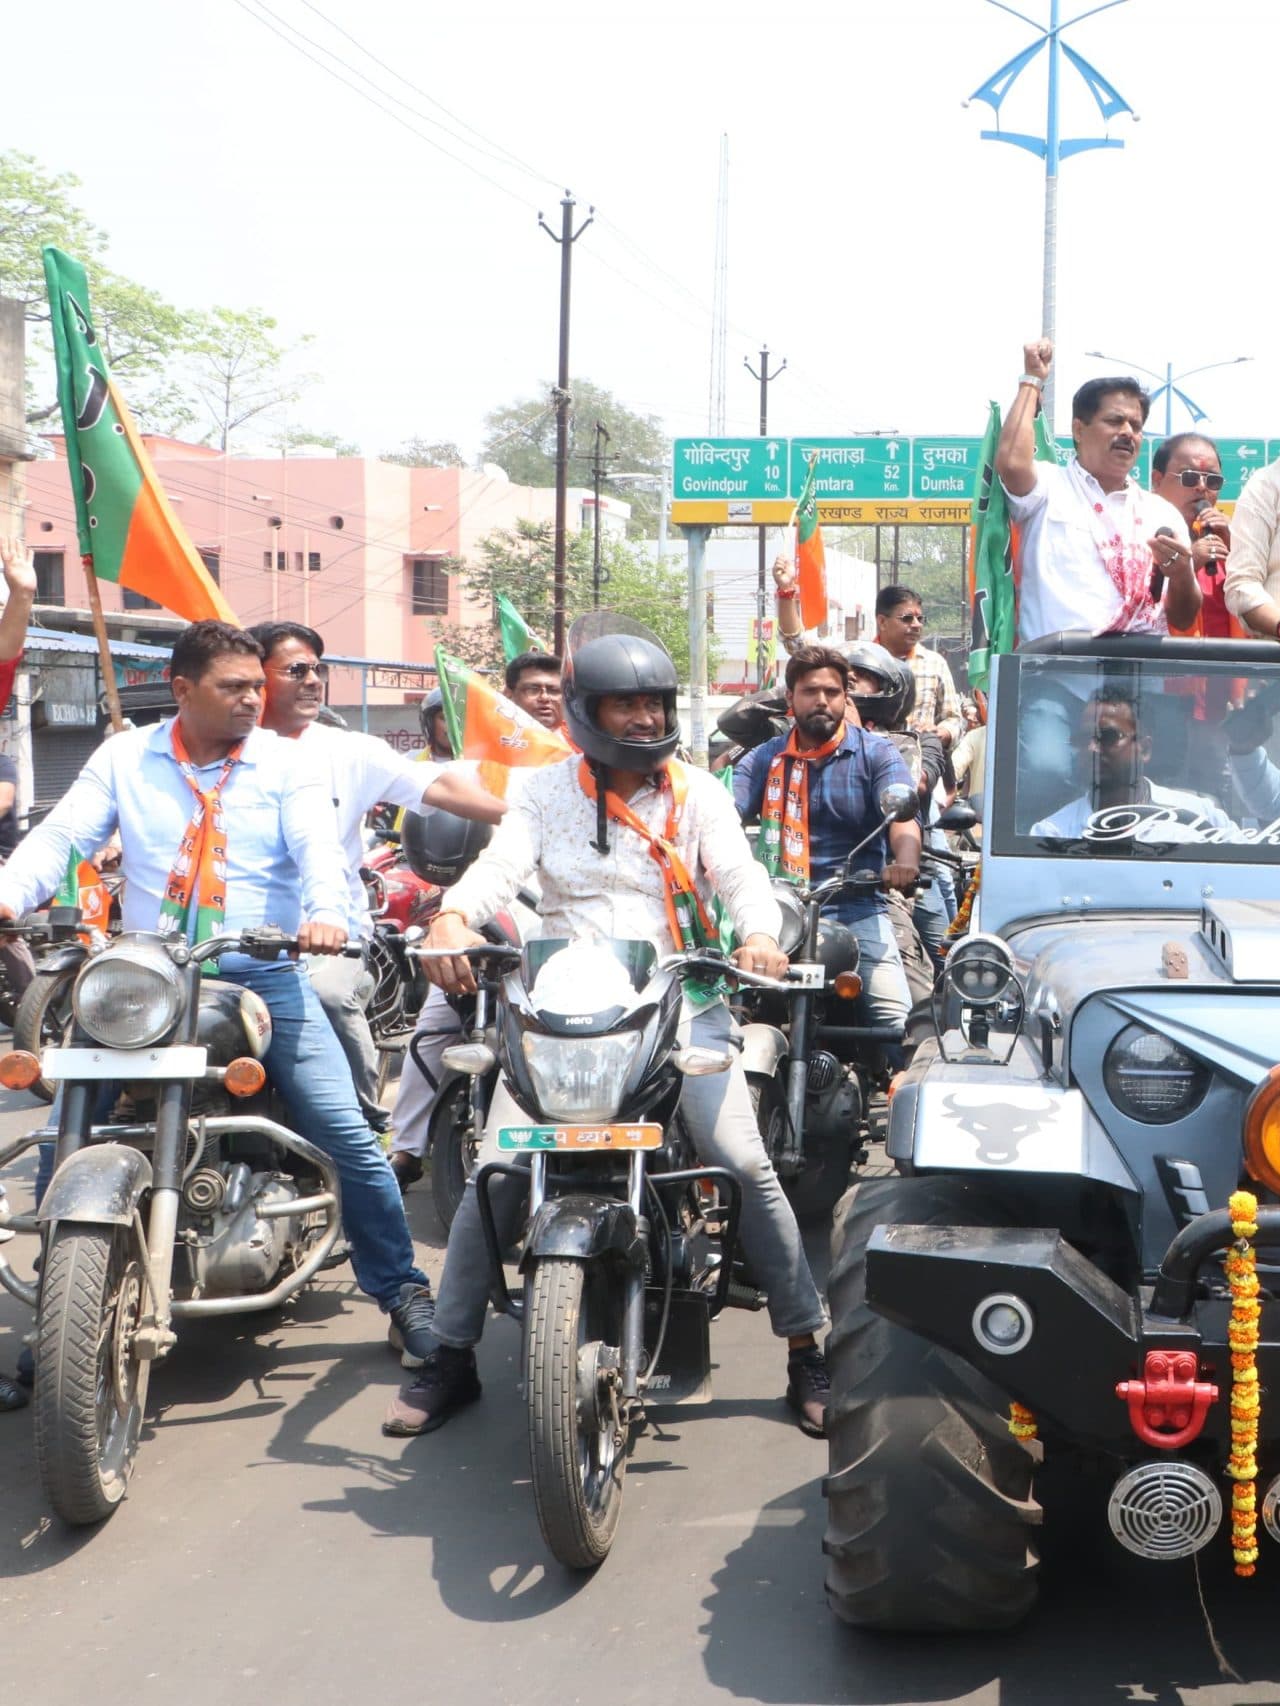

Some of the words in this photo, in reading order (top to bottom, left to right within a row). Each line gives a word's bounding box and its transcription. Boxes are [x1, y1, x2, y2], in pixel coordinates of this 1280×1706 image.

[683, 442, 751, 472] गोविन्दपुर
[922, 447, 968, 471] दुमका
[764, 465, 780, 479] 10
[884, 465, 900, 479] 52
[682, 477, 748, 495] Govindpur
[800, 474, 854, 492] mtara
[921, 477, 964, 491] Dumka
[817, 507, 862, 519] रखण्ड
[875, 507, 908, 521] राज्य
